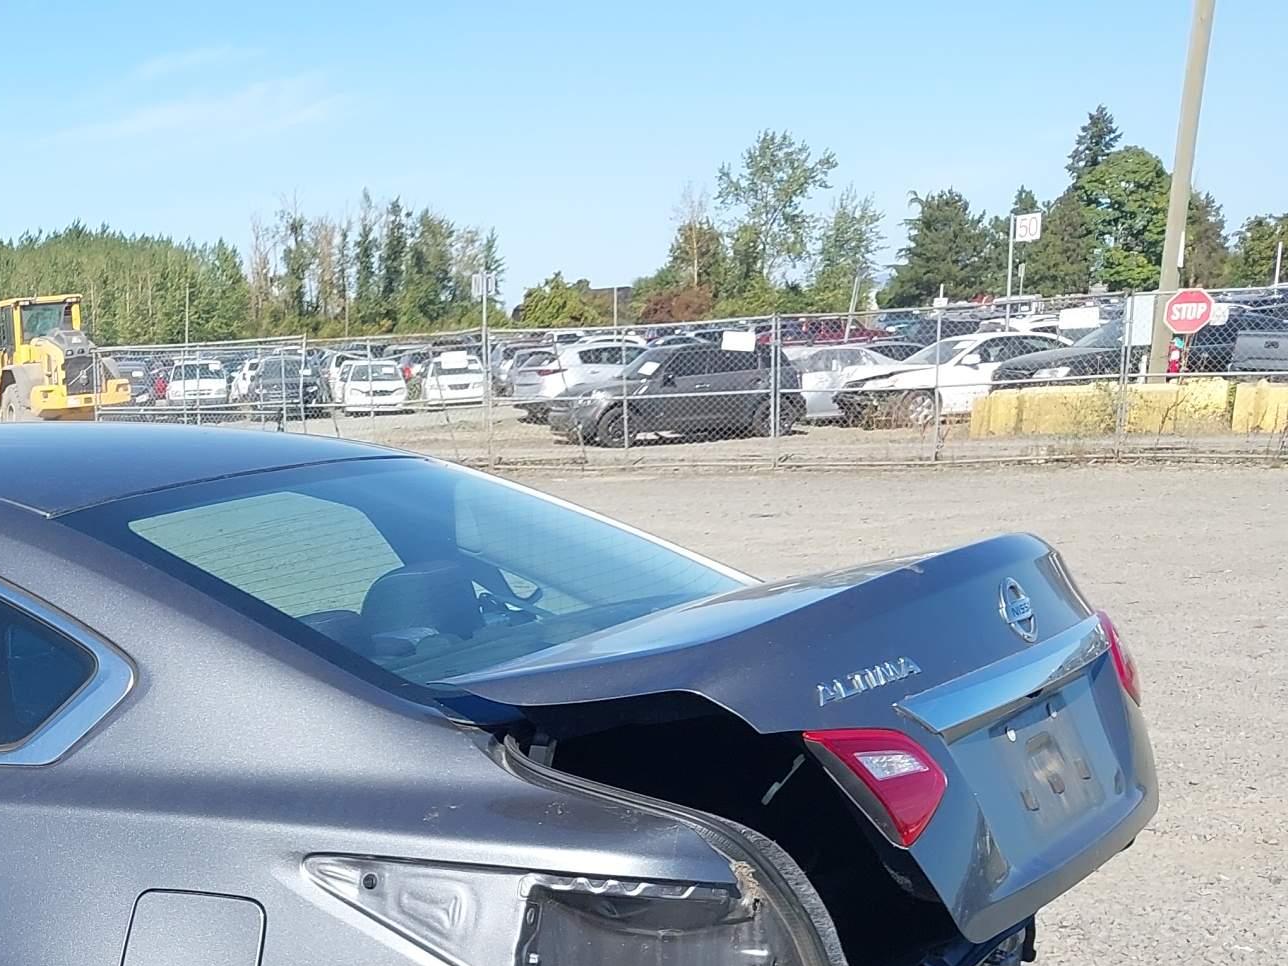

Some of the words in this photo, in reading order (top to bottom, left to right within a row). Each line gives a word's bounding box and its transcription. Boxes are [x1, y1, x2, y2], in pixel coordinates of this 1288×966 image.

[1019, 217, 1038, 238] 50
[1171, 303, 1208, 321] STOP
[816, 657, 922, 707] ALTIMA
